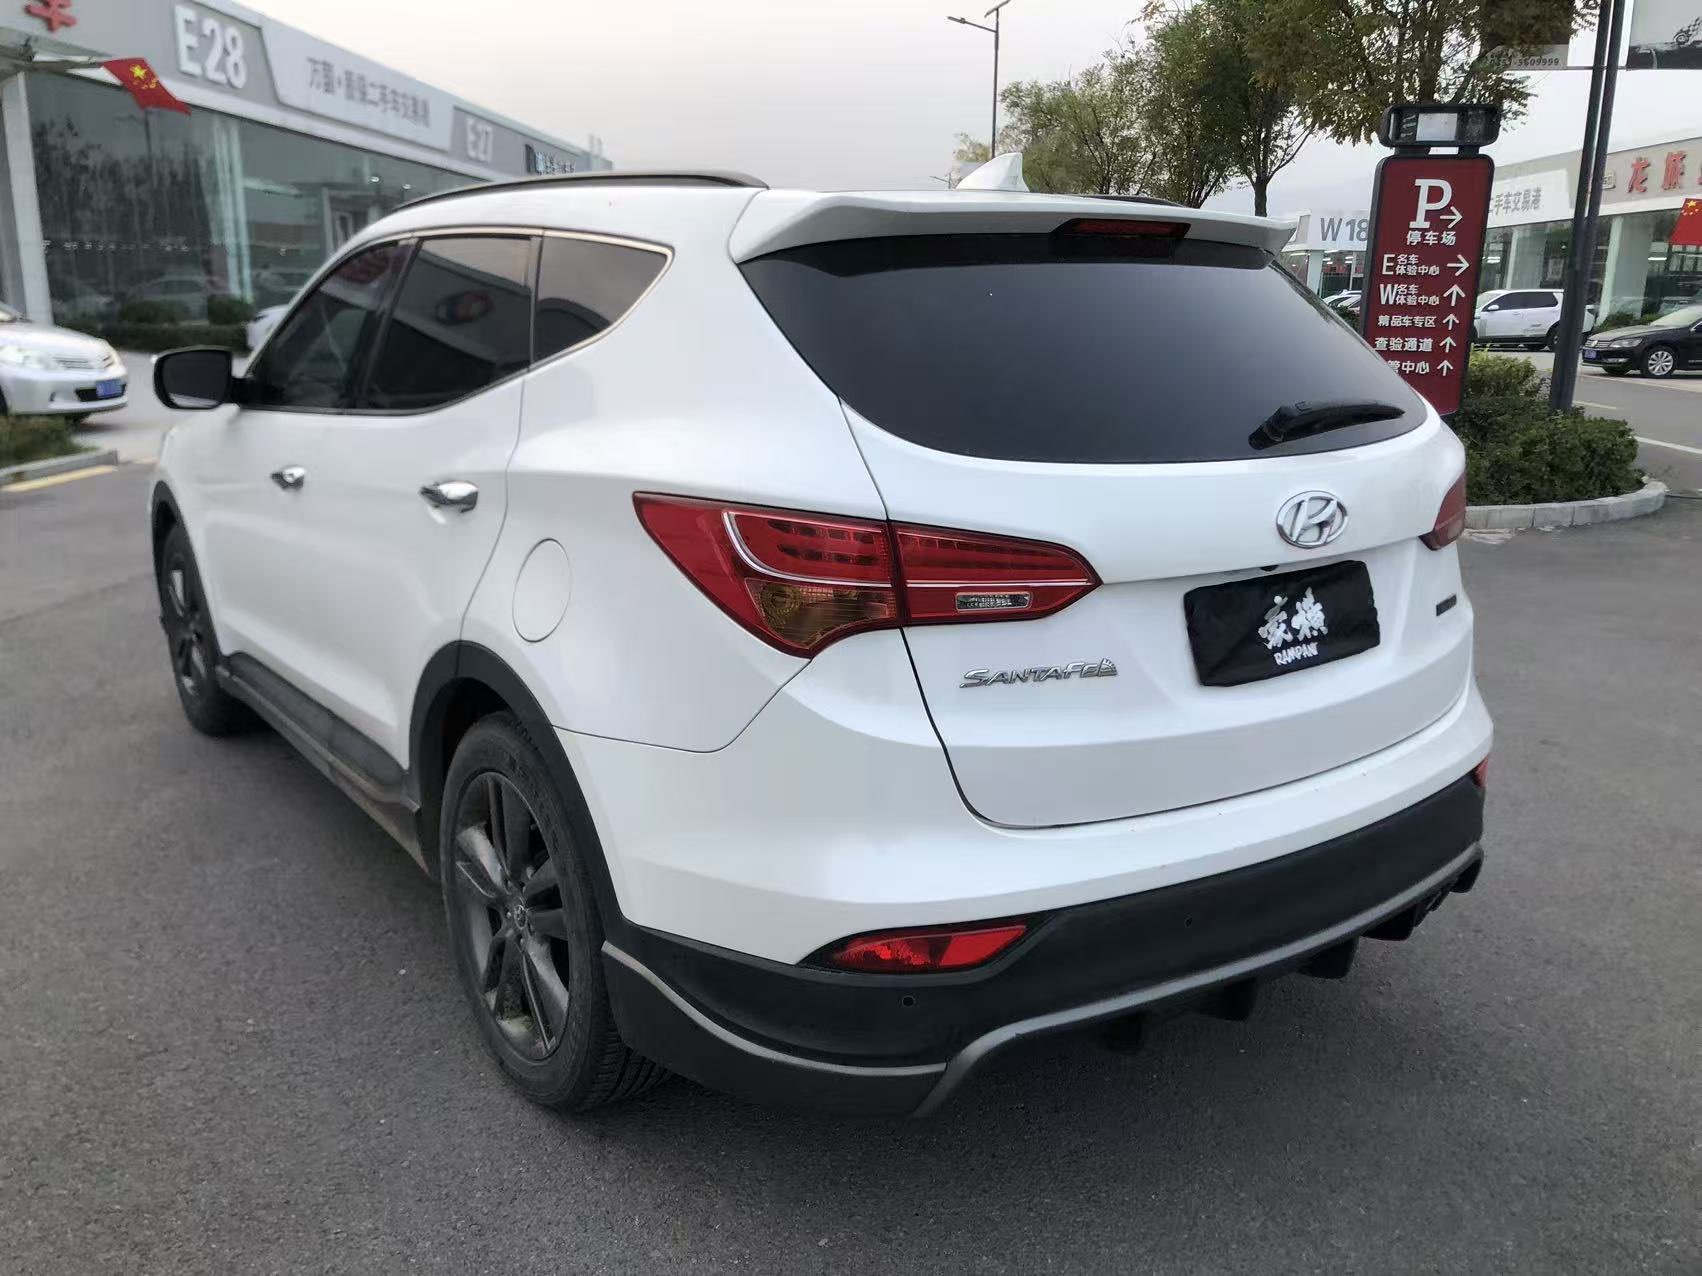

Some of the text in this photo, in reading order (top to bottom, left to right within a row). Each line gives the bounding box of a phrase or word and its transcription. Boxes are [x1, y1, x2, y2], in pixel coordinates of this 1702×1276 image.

[175, 5, 248, 89] E28
[1409, 178, 1453, 229] P
[1320, 217, 1369, 242] W18
[1406, 230, 1456, 247] 停车场
[1382, 253, 1419, 276] E 名车
[1395, 264, 1440, 276] 体验中心
[1379, 283, 1419, 305] W 名车
[1395, 294, 1440, 306] 体验中心
[1377, 315, 1437, 328] 精品车专区
[1374, 337, 1434, 352] 查验通道
